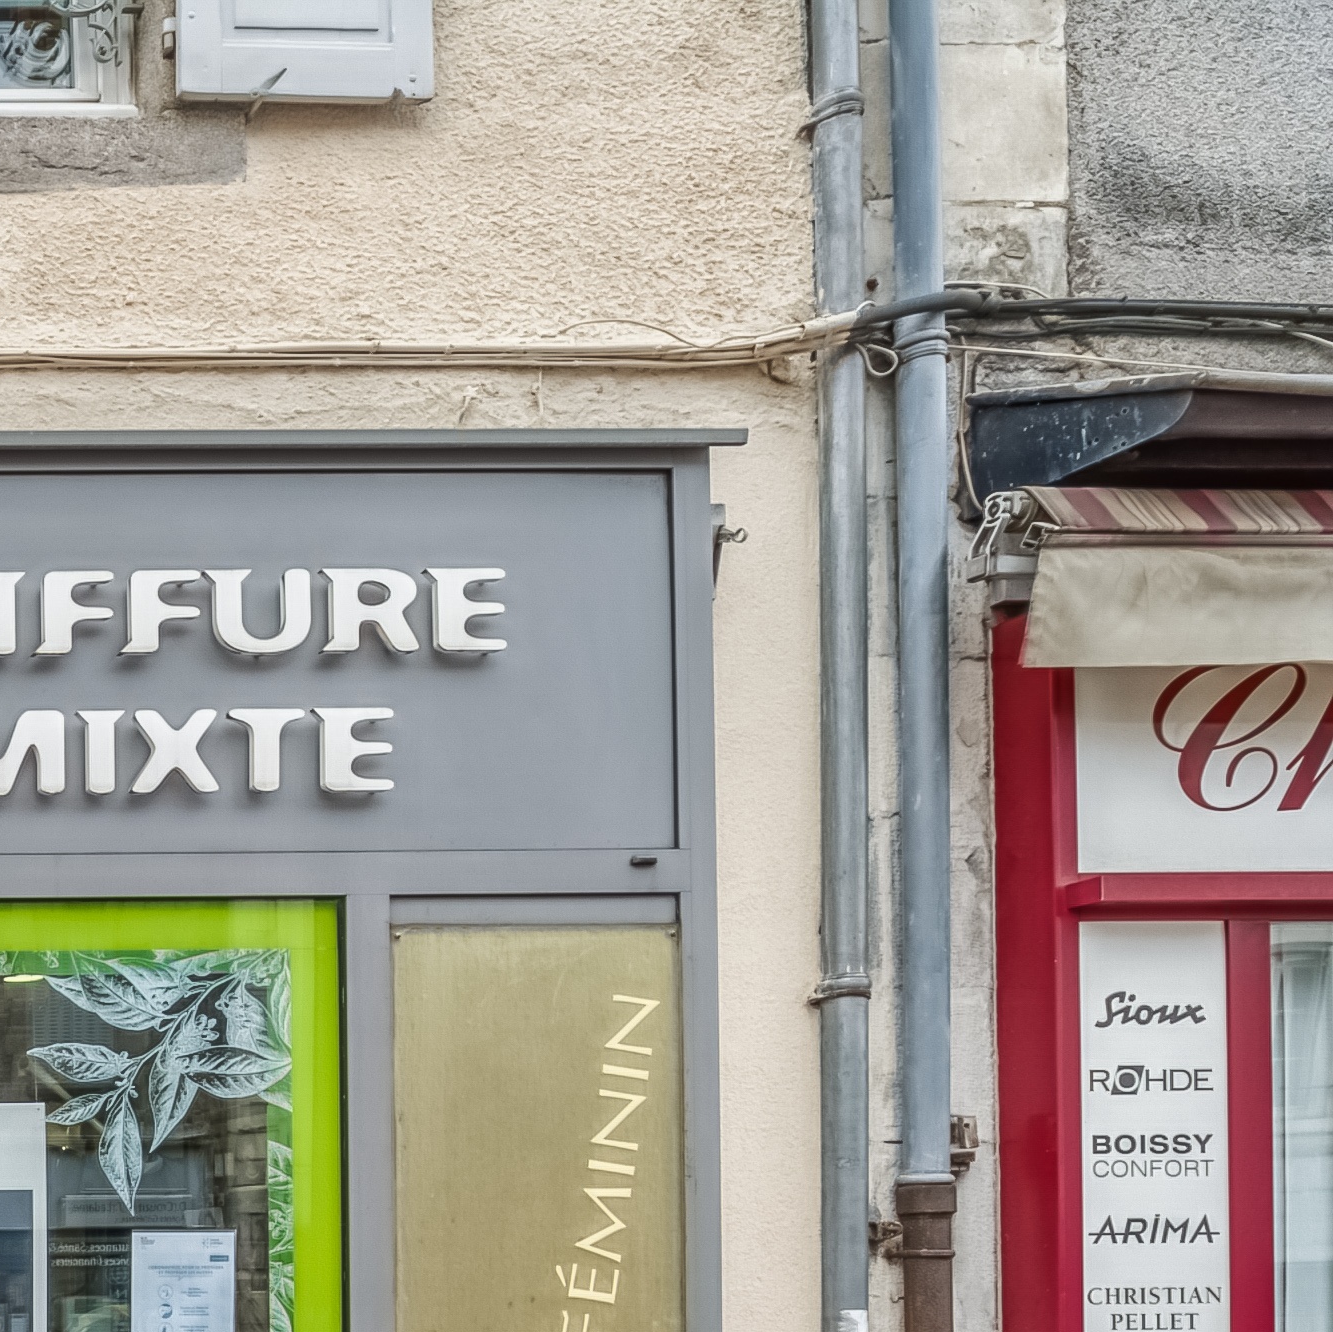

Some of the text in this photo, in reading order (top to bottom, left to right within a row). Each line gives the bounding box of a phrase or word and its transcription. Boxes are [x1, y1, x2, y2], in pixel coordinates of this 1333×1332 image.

[1094, 991, 1206, 1028] Sioux
[1089, 1065, 1214, 1096] ROHDE
[1092, 1133, 1214, 1155] BOISSY
[1092, 1159, 1215, 1178] CONFORT
[1087, 1285, 1223, 1306] CHRISTIAN
[1110, 1312, 1200, 1332] PELLET
